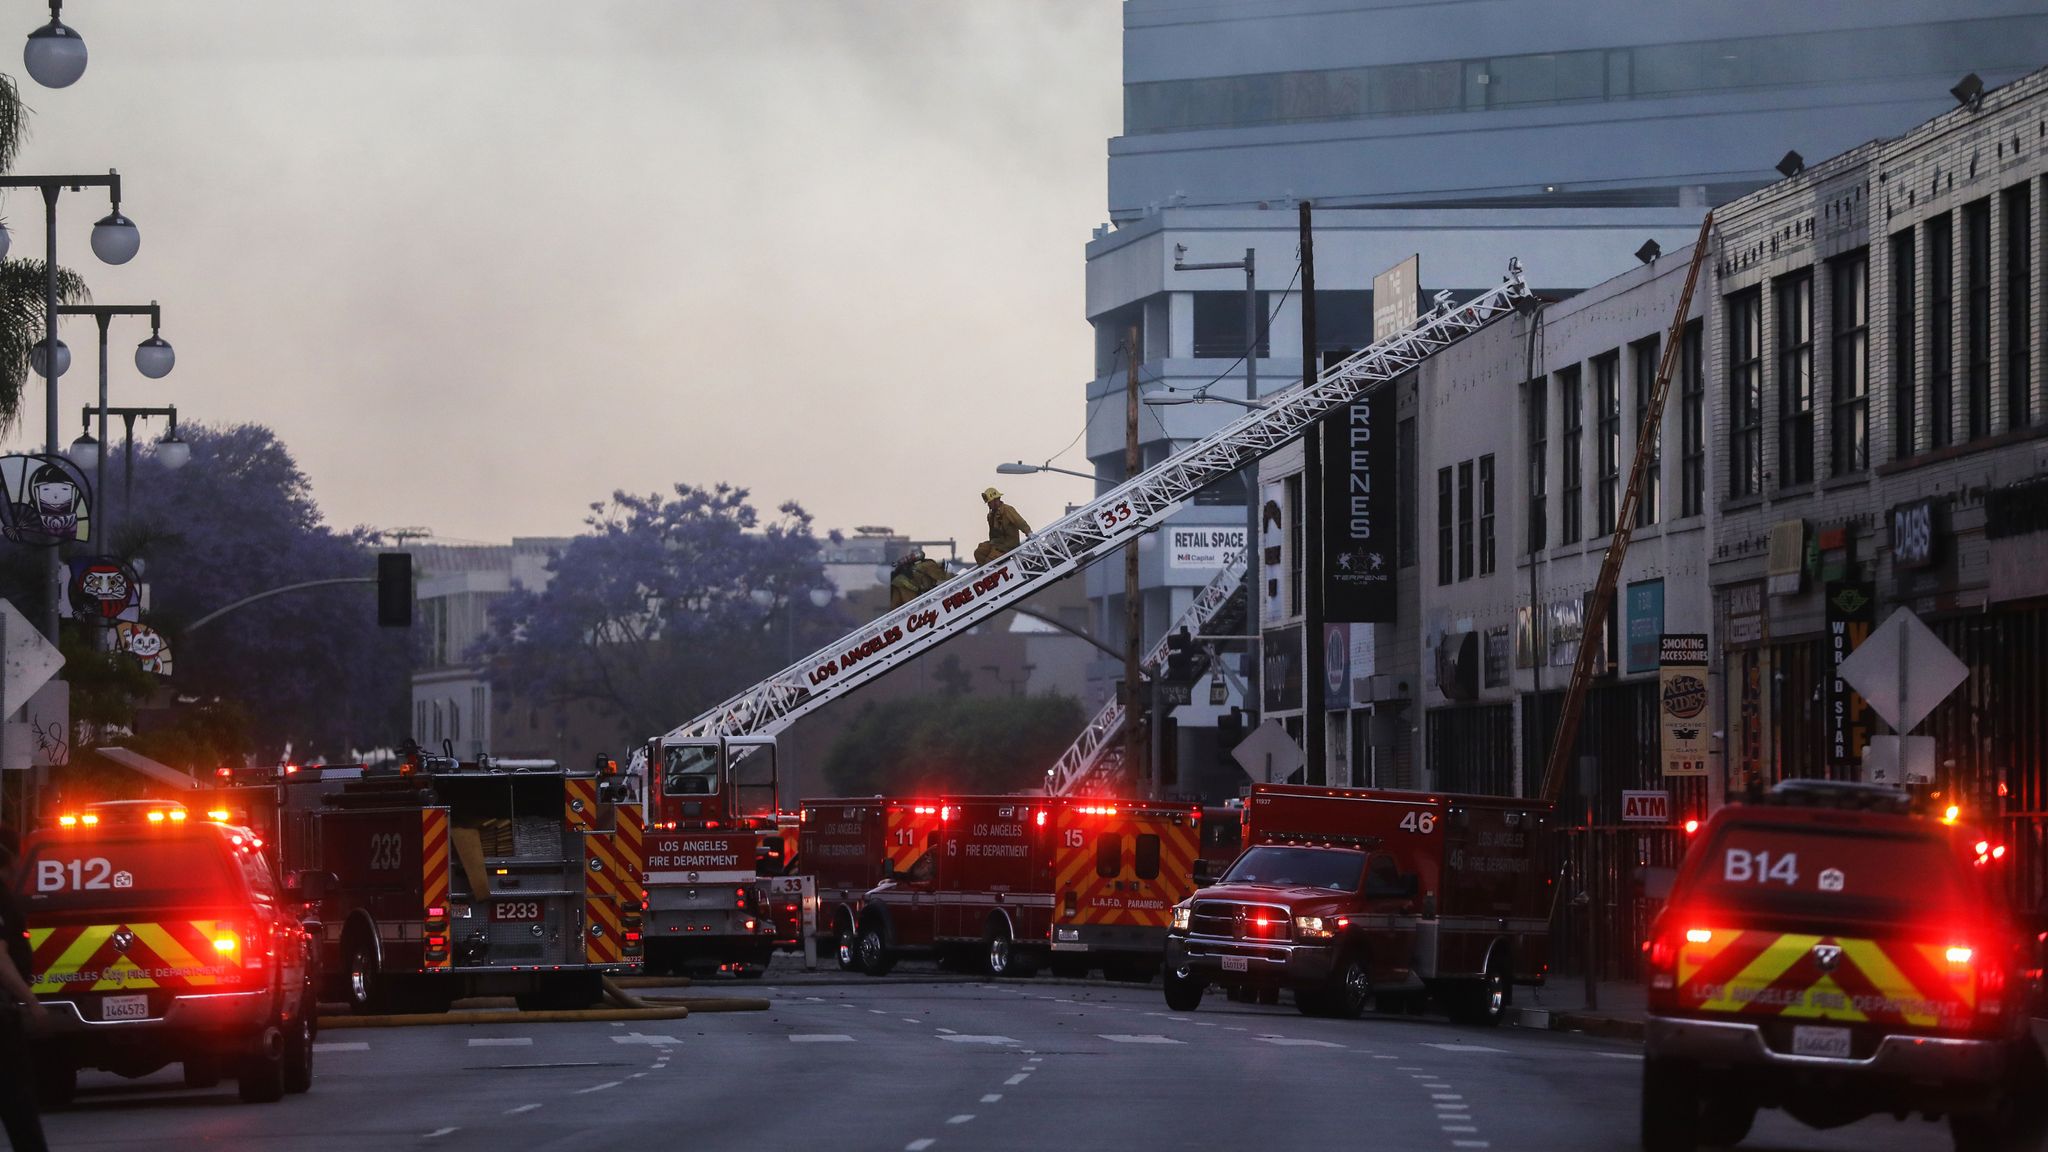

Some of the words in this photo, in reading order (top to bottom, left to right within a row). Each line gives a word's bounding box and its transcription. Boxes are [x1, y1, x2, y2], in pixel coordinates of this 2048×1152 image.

[1349, 397, 1371, 539] RPENES
[1101, 500, 1132, 529] 33
[1175, 532, 1209, 548] RETAIL
[1211, 532, 1244, 548] SPACE
[1894, 504, 1931, 558] DABS
[1191, 553, 1215, 563] Capital
[808, 660, 839, 686] LOS
[840, 625, 903, 671] ANGELES
[906, 608, 940, 633] City
[942, 586, 975, 614] FIRE
[972, 566, 1014, 598] DEPT.
[1662, 638, 1704, 649] SMOKING
[1660, 649, 1708, 661] ACCESSORIES
[1832, 621, 1845, 693] WORD
[1834, 701, 1845, 758] STAR
[1625, 797, 1667, 817] ATM
[824, 823, 836, 836] LOS
[837, 823, 862, 836] ANGELES
[973, 825, 988, 837] LOS
[990, 825, 1022, 837] ANGELES
[1399, 811, 1434, 834] 46
[659, 841, 679, 852] LOS
[683, 840, 728, 851] ANGELES
[895, 828, 914, 846] 11
[1064, 829, 1083, 848] 15
[1478, 831, 1492, 847] LOS
[1493, 832, 1524, 848] ANGELES
[370, 832, 402, 870] 233
[946, 839, 957, 857] 15
[965, 844, 981, 856] FIRE
[982, 845, 1028, 857] DEPARTMENT
[649, 855, 670, 866] FIRE
[673, 855, 739, 866] DEPARTMENT
[1449, 848, 1464, 871] 46
[1724, 848, 1799, 885] B14
[37, 858, 112, 892] B12
[784, 879, 801, 891] 33
[496, 902, 538, 919] E233
[1092, 897, 1122, 908] L.A.F.D.
[1127, 899, 1164, 909] PARAMEDIC
[31, 975, 44, 984] OS
[48, 971, 98, 985] ANGELES
[102, 966, 127, 986] City
[128, 968, 151, 980] FIRE
[155, 965, 226, 978] DEPARTMENT
[1692, 983, 1724, 999] LOS
[1733, 986, 1804, 1006] ANGELES
[1811, 991, 1846, 1008] FIRE
[1852, 994, 1958, 1016] DEPARTMENT
[105, 1005, 146, 1019] 1464573
